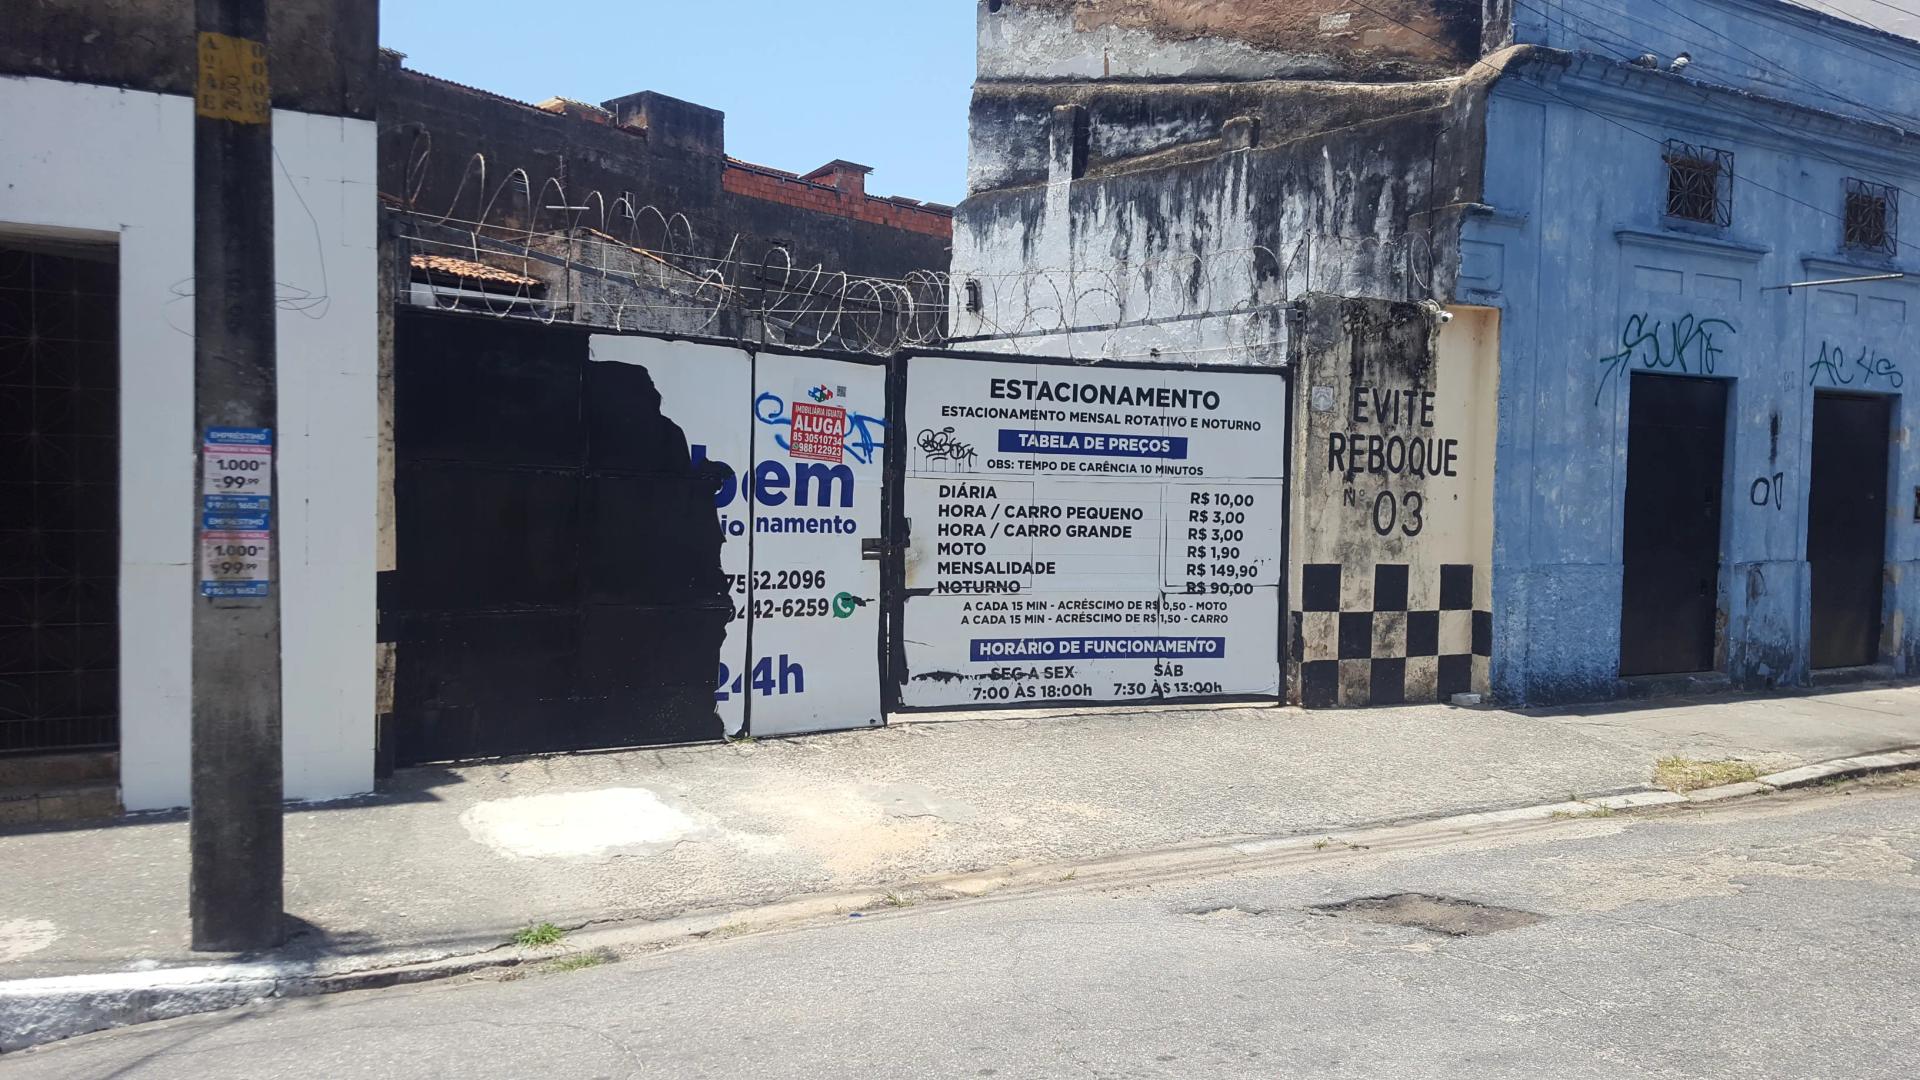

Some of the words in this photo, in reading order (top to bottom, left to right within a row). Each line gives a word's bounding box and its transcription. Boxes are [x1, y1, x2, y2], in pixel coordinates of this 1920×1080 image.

[990, 378, 1220, 411] ESTACIONAMENTO
[1353, 387, 1436, 427] EVITE
[794, 414, 843, 436] ALUGA
[941, 405, 1066, 422] ESTACIONAMENTO
[1069, 409, 1121, 425] MENSAL
[1125, 413, 1187, 428] ROTATIVO
[1191, 416, 1199, 428] E
[1201, 417, 1261, 431] NOTURNO
[793, 431, 803, 442] 85
[804, 432, 842, 446] 30510734
[1018, 433, 1080, 450] TABELA
[1084, 437, 1105, 451] DE
[1108, 437, 1170, 454] PREÇOS
[799, 443, 842, 457] 988122923
[1328, 432, 1458, 480] REBOQUE
[987, 459, 1015, 470] OBS:
[1017, 460, 1058, 471] TEMPO
[1060, 462, 1077, 472] DE
[1079, 460, 1138, 474] CARÊNCIA
[1140, 464, 1152, 474] 10
[1155, 464, 1204, 476] MINUTOS
[938, 484, 997, 500] DIÁRIA
[1190, 491, 1210, 506] R$
[1214, 493, 1254, 508] 10,00
[938, 504, 986, 518] HORA
[990, 504, 1000, 519] /
[1004, 505, 1062, 519] CARRO
[1066, 506, 1143, 521] PEQUENO
[1189, 510, 1209, 525] R$
[1212, 511, 1245, 526] 3,00
[1372, 490, 1424, 537] 03
[937, 523, 986, 537] HORA
[990, 523, 999, 537] /
[1004, 524, 1061, 538] CARRO
[1065, 525, 1132, 539] GRANDE
[1188, 527, 1208, 542] R$
[1211, 528, 1244, 544] 3,00
[937, 542, 986, 556] MOTO
[1187, 545, 1206, 560] R$
[1210, 546, 1240, 562] 1,90
[937, 561, 1056, 575] MENSALIDADE
[1186, 563, 1206, 578] R$
[1209, 564, 1258, 580] 149,90
[937, 580, 1021, 594] NOTURNO
[1186, 581, 1206, 596] R$
[1209, 582, 1254, 598] 90,00
[963, 602, 972, 611] A
[975, 601, 1008, 611] CADA
[1012, 601, 1023, 611] 15
[1026, 601, 1047, 611] MIN
[1057, 598, 1124, 611] ACRÉSCIMO
[1127, 600, 1142, 610] DE
[1145, 600, 1158, 611] R$
[1163, 601, 1186, 612] 0,50
[1196, 601, 1228, 611] MOTO
[961, 615, 969, 625] A
[972, 615, 1006, 625] CADA
[1010, 615, 1021, 624] 15
[1024, 614, 1045, 624] MIN
[1055, 611, 1122, 624] ACRÉSCIMO
[1125, 613, 1140, 623] DE
[1143, 613, 1157, 624] R$
[1160, 614, 1181, 625] 1,50
[1191, 614, 1229, 624] CARRO
[980, 639, 1055, 656] HORÁRIO
[1059, 641, 1081, 654] DE
[1084, 639, 1217, 653] FUNCIONAMENTO
[714, 653, 804, 702] 24h
[991, 667, 1023, 680] SEG
[1029, 667, 1039, 679] A
[1044, 666, 1075, 679] SEX
[1154, 661, 1184, 677] SÁB
[973, 686, 1010, 701] 7:00
[1014, 682, 1036, 698] ÀS
[1040, 683, 1093, 698] 18:00h
[1113, 682, 1146, 696] 7:30
[1151, 679, 1171, 695] ÀS
[1174, 682, 1223, 694] 13:00h
